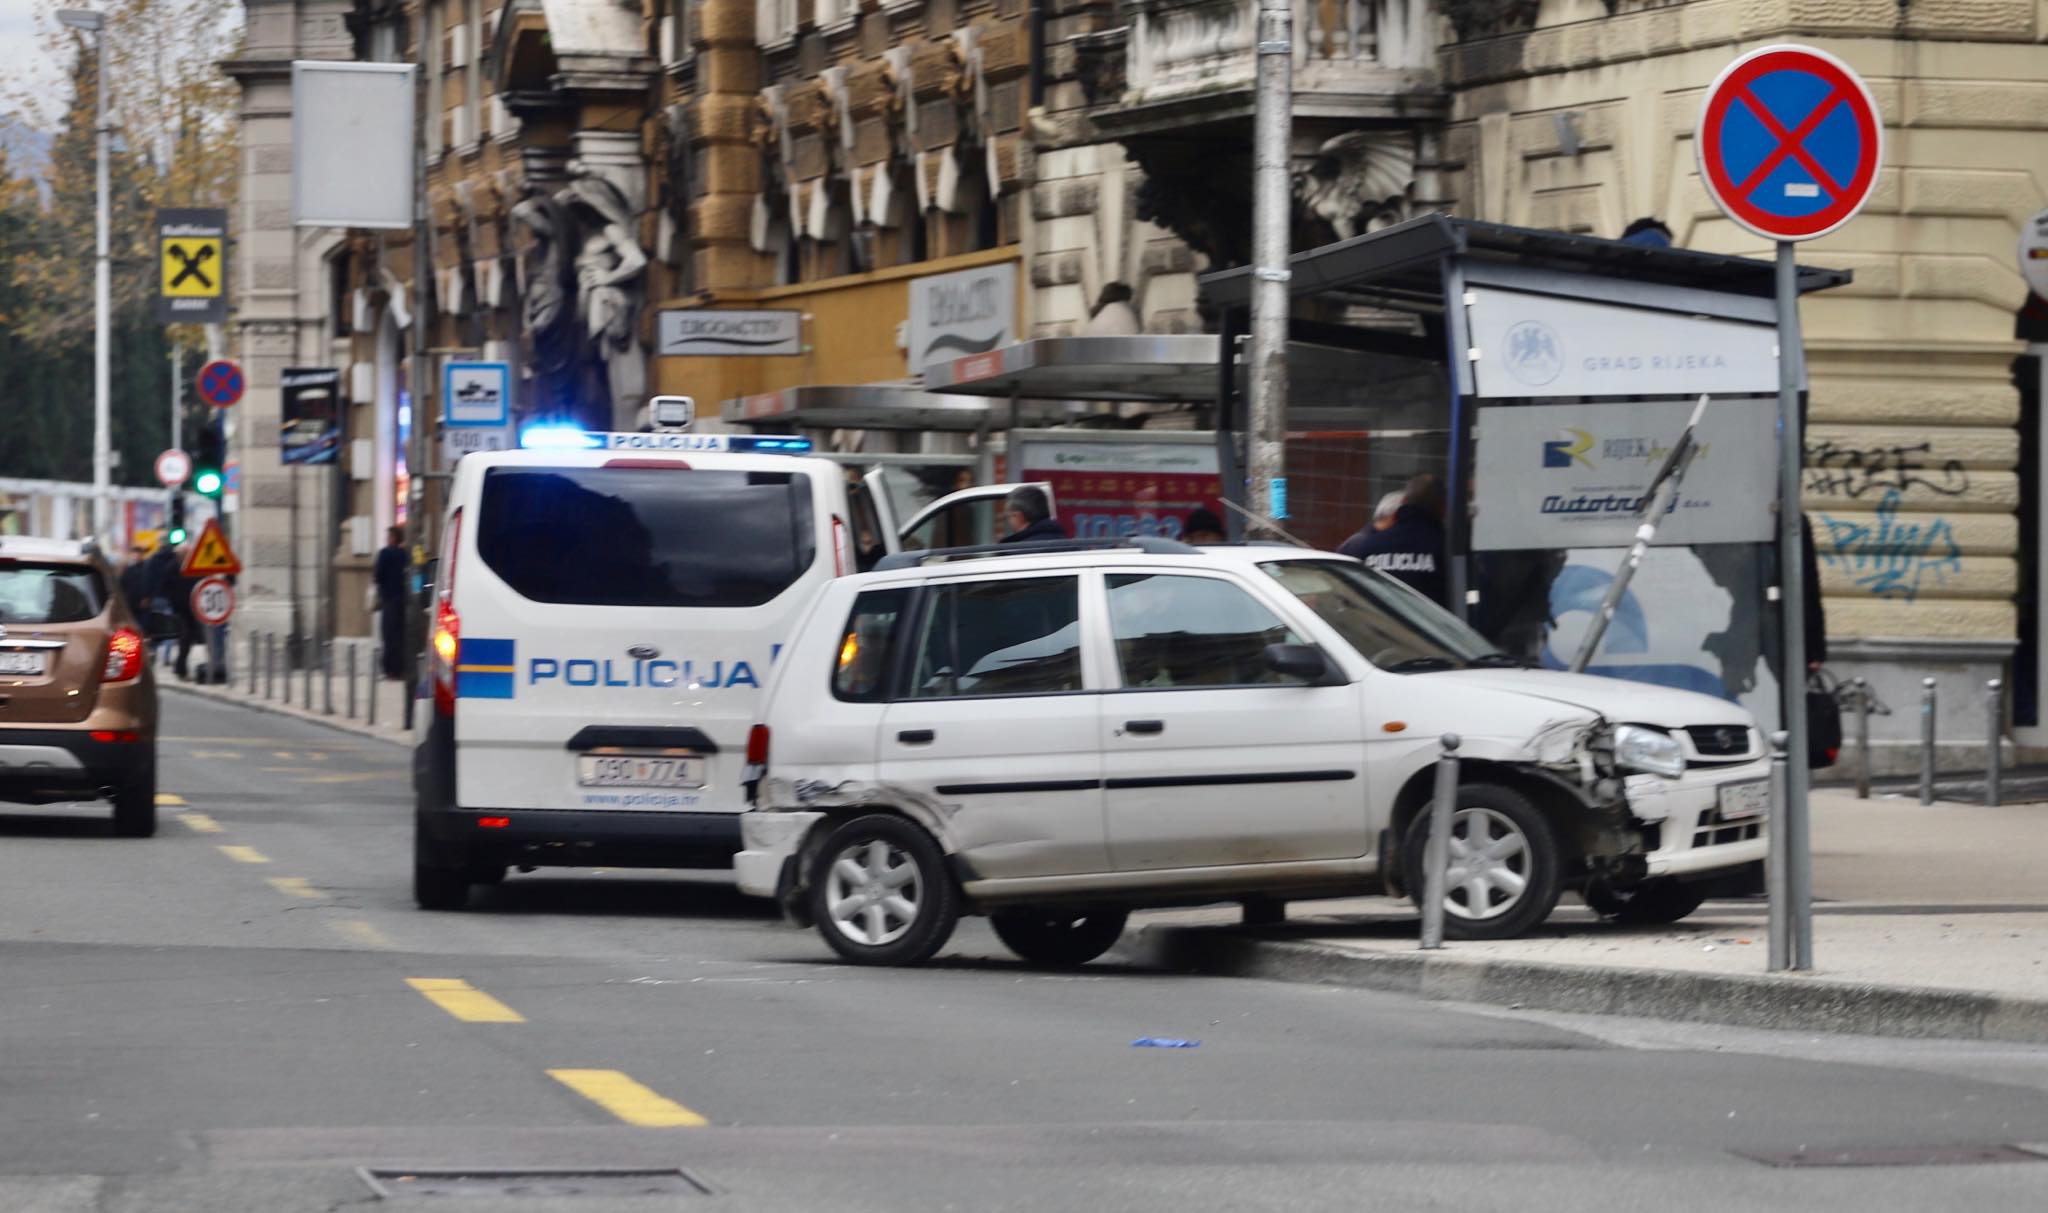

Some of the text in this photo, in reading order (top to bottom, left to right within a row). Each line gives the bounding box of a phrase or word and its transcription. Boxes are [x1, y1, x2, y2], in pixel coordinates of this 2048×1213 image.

[1582, 354, 1727, 371] GRAD RIJEKA
[614, 435, 719, 449] POLICIJA
[529, 658, 760, 689] POLICIJA
